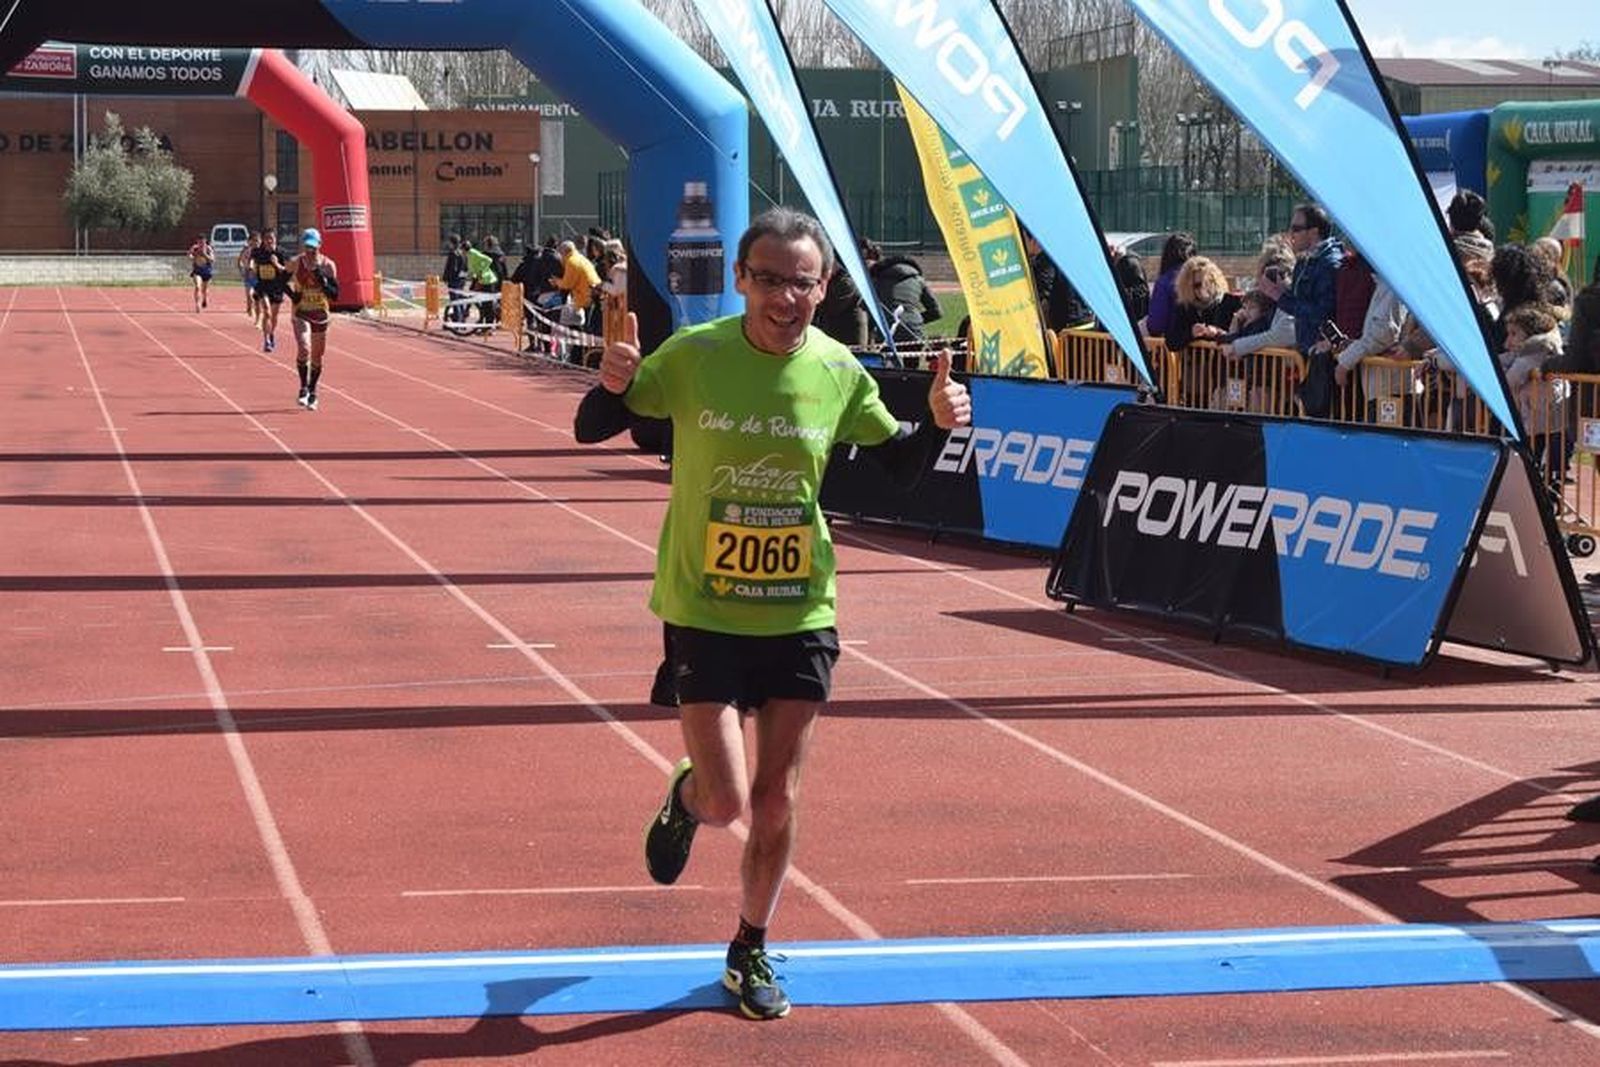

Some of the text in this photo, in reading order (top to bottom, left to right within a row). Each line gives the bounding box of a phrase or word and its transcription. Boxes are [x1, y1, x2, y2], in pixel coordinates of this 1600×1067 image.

[89, 47, 222, 62] CON EL DEPORTE
[89, 65, 222, 81] GANAMOS TODOS
[19, 134, 51, 151] DE
[740, 414, 763, 434] de
[1102, 470, 1439, 579] POWERADE
[715, 531, 800, 575] 2066
[735, 584, 805, 597] CAJA RURAL
